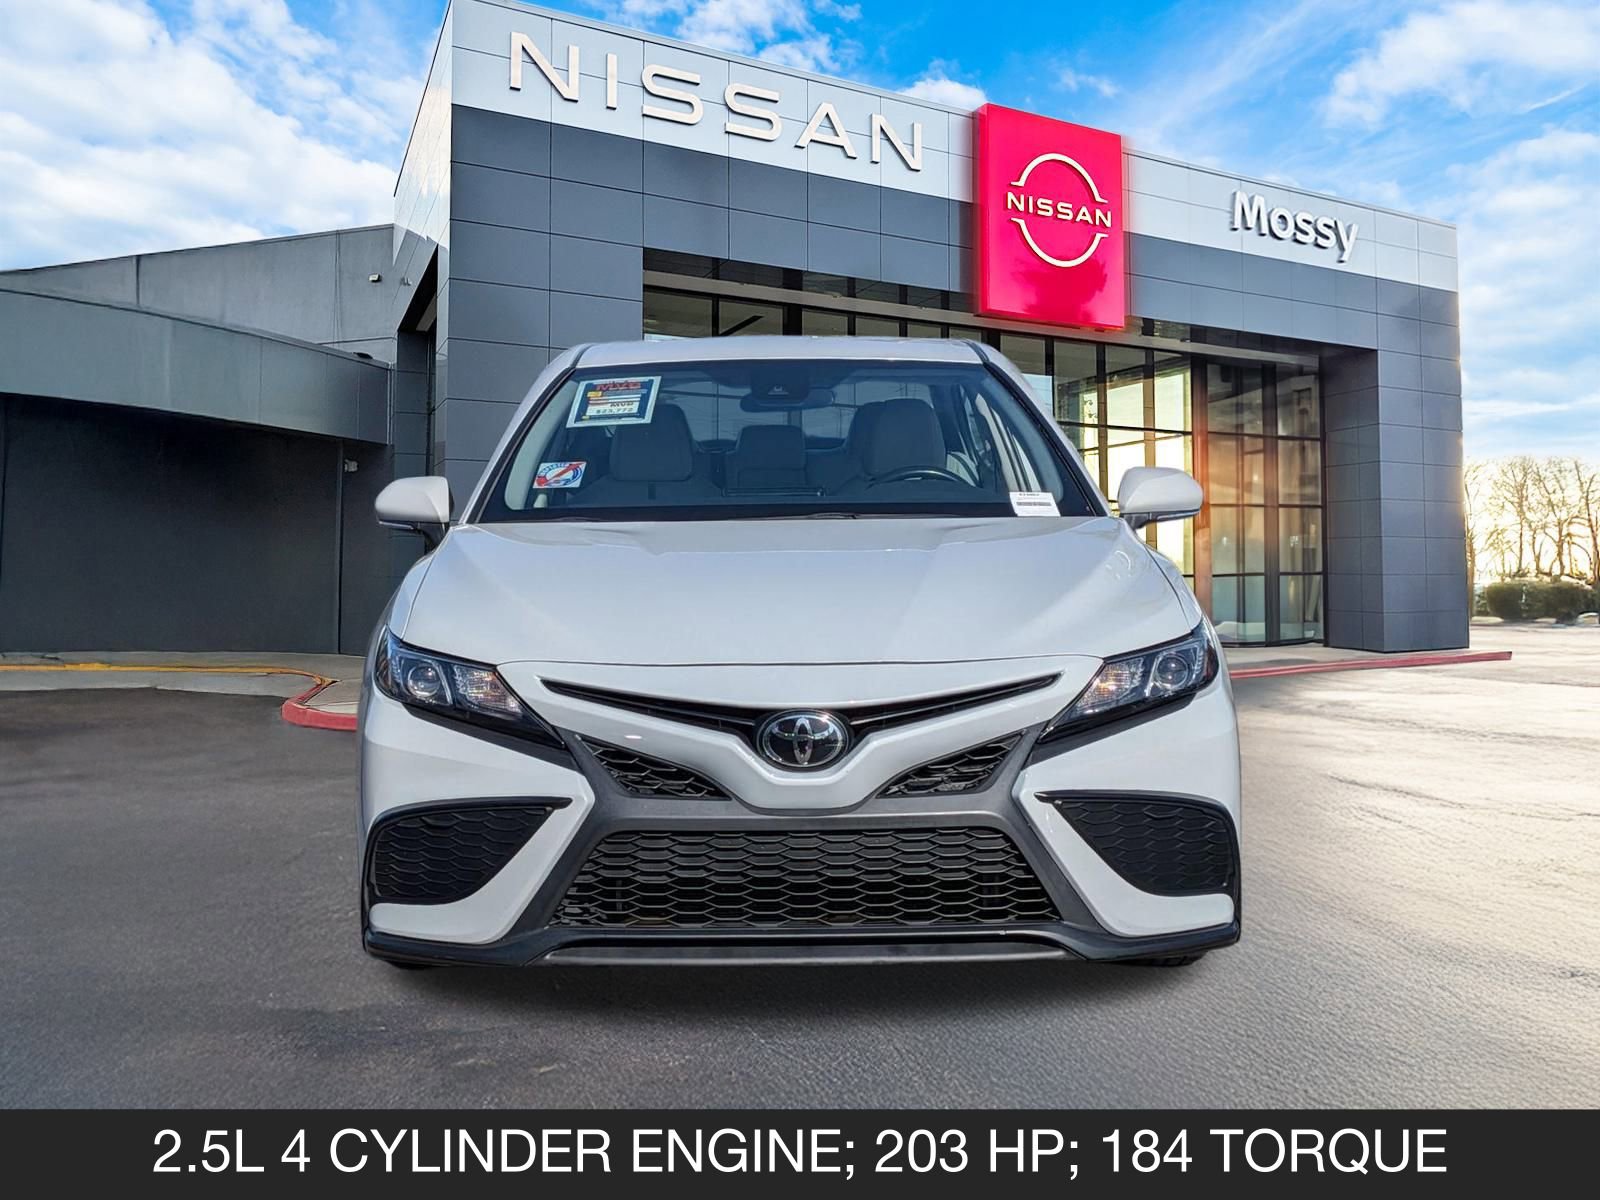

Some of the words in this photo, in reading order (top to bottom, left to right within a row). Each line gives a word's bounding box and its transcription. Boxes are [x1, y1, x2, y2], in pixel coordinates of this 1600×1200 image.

[509, 31, 922, 172] NISSAN
[1006, 191, 1112, 228] NISSAN
[1230, 189, 1360, 263] Mossy
